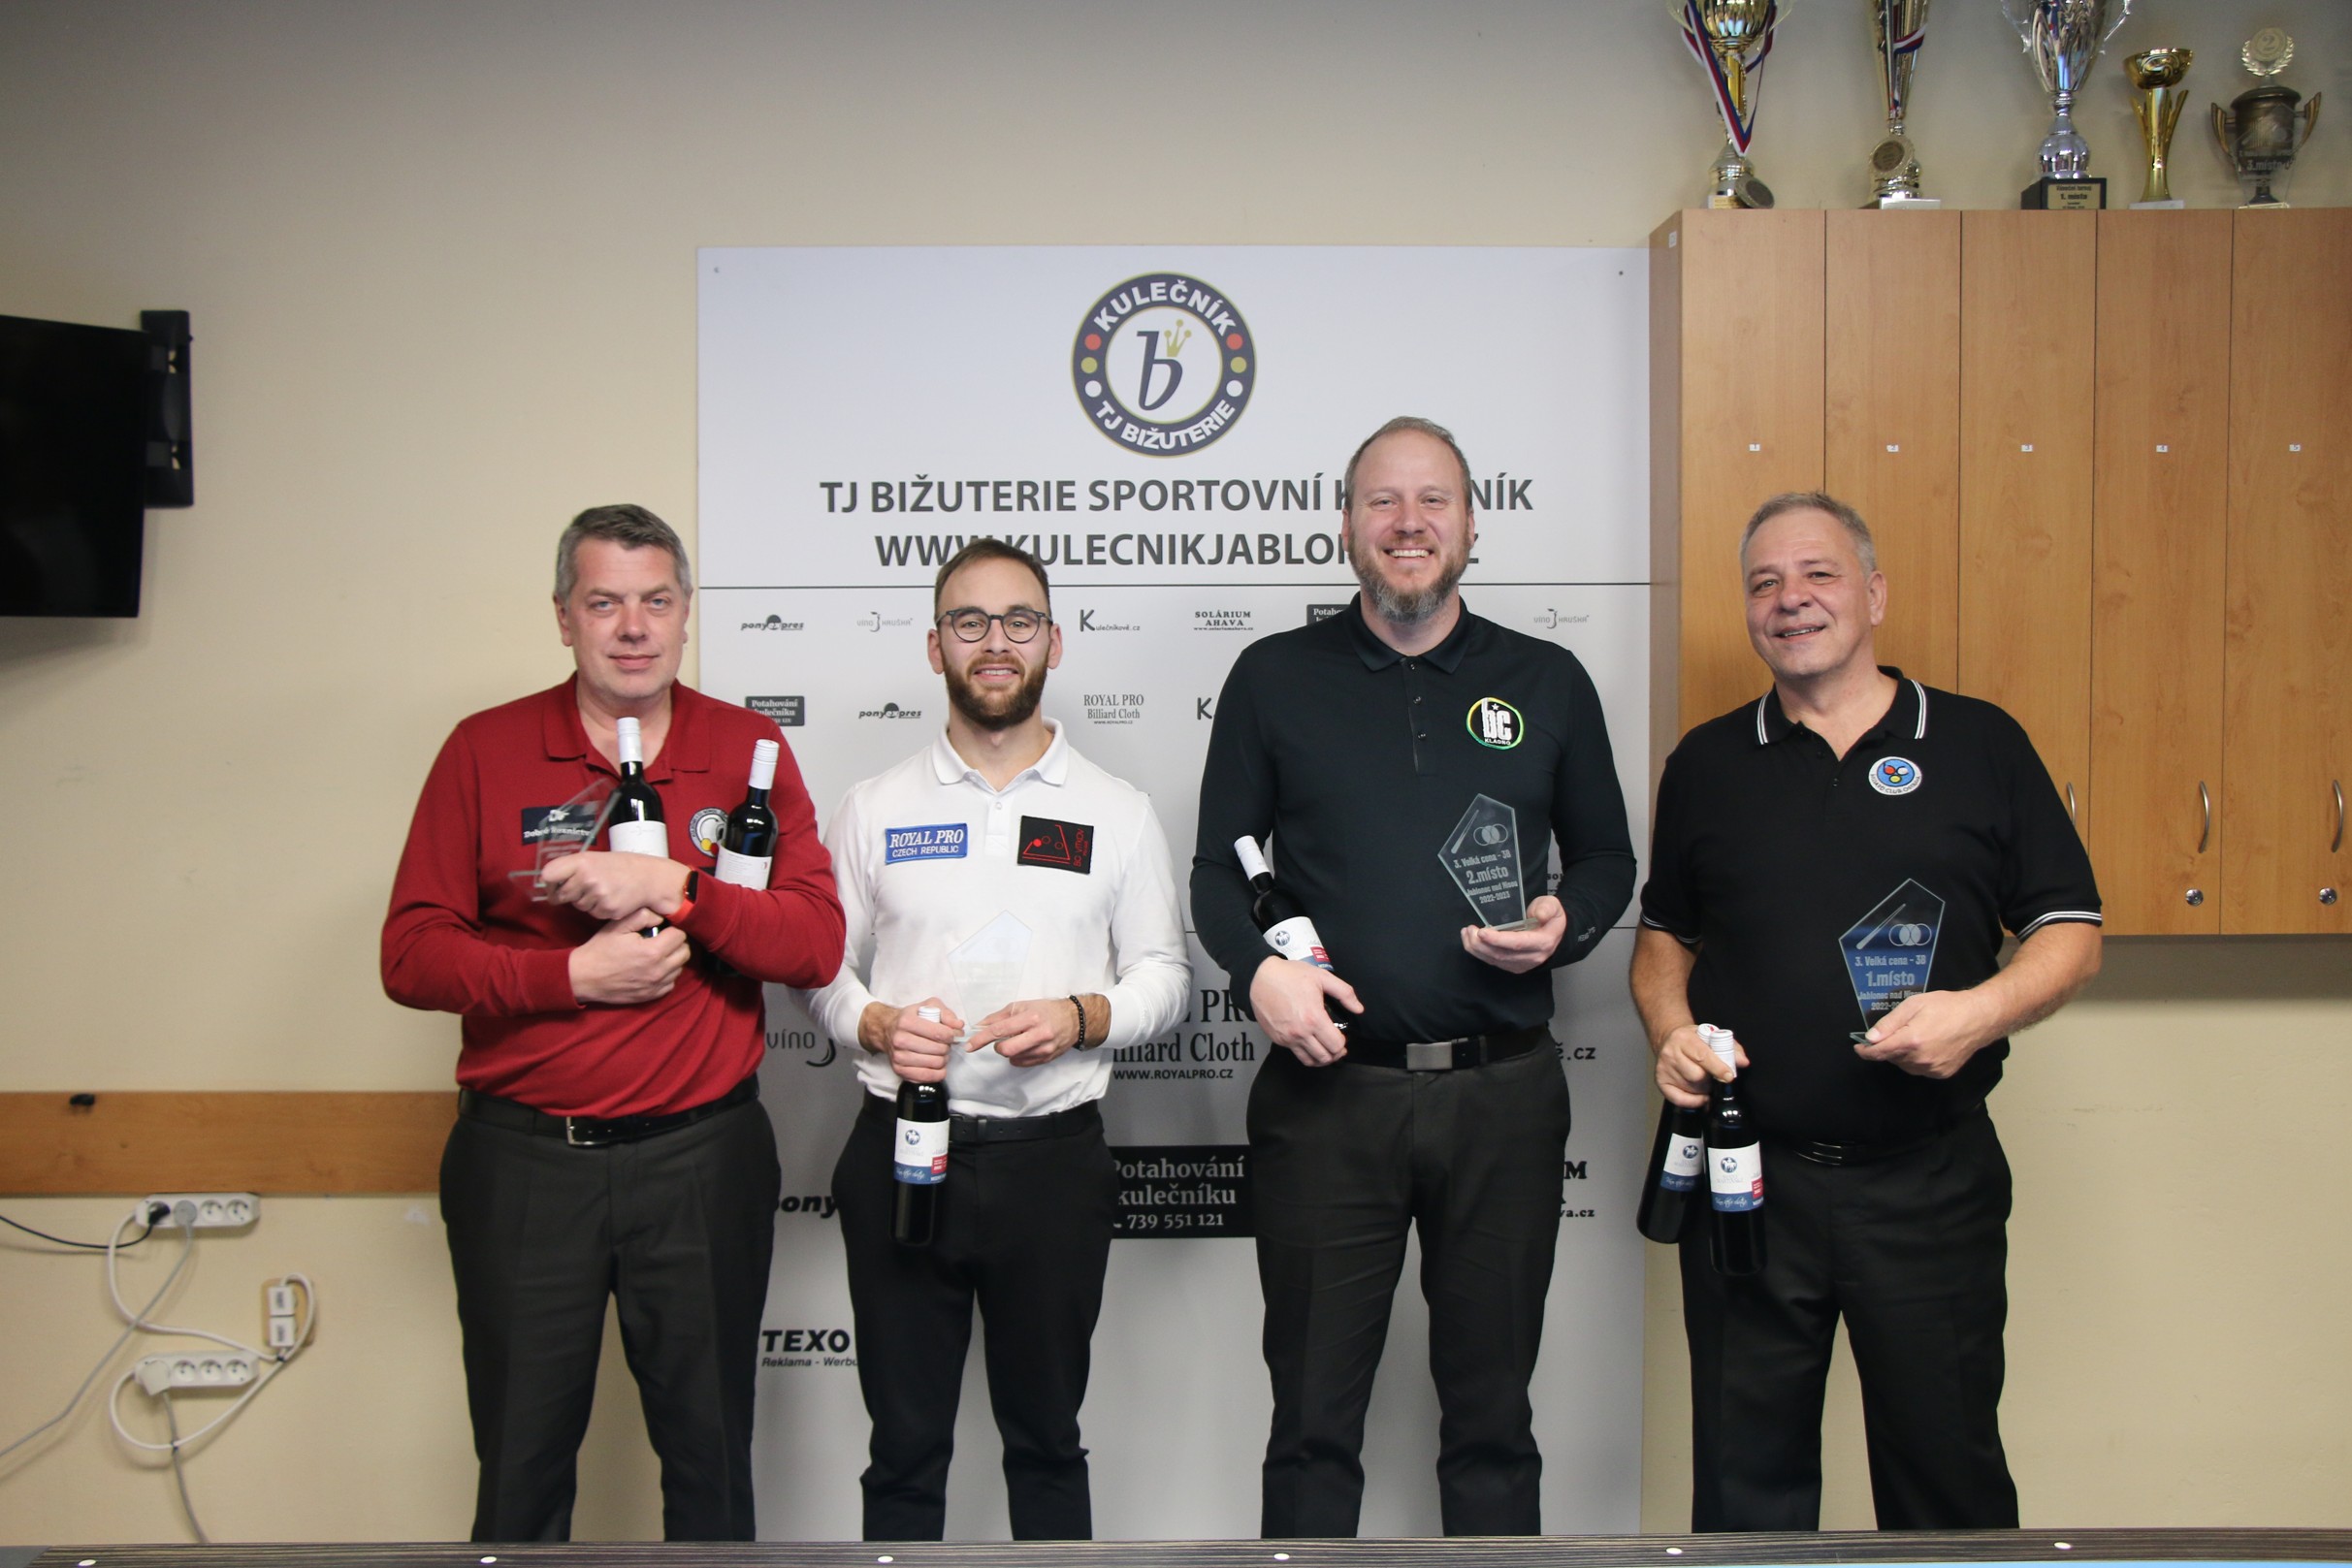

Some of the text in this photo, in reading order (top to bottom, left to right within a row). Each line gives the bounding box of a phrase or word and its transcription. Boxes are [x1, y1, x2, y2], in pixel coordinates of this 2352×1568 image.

[1093, 279, 1237, 336] KULEČNÍK
[1096, 400, 1236, 449] TJ BIŽUTERIE
[820, 472, 1534, 513] TJ BIŽUTERIE SPORTOVNÍ KNÍK
[1194, 609, 1251, 618] SOLÁRIUM
[751, 698, 798, 708] Potahování
[1083, 693, 1144, 707] ROYAL PRO
[754, 708, 795, 717] ulečníku
[1087, 708, 1141, 719] Billiard Cloth
[888, 828, 965, 848] ROYAL PRO
[892, 845, 959, 858] CZECH REPUBLIC
[1453, 859, 1463, 869] 3.
[1461, 855, 1481, 867] Velká
[1481, 853, 1498, 863] cena
[1466, 865, 1509, 884] 2.místo
[1854, 956, 1863, 967] 3.
[1865, 955, 1887, 967] Velká
[1888, 955, 1909, 966] cena
[1865, 971, 1916, 987] 1.místo
[1859, 990, 1889, 1000] Jablonec
[1889, 989, 1903, 1000] nad
[1201, 989, 1258, 1023] PR
[766, 1028, 816, 1049] víno
[1190, 1032, 1255, 1062] Cloth
[1113, 1069, 1234, 1080] WWW.ROYALPRO.CZ
[1126, 1213, 1224, 1230] 739 551 121
[761, 1328, 851, 1354] TEXO
[761, 1357, 812, 1367] Reklama
